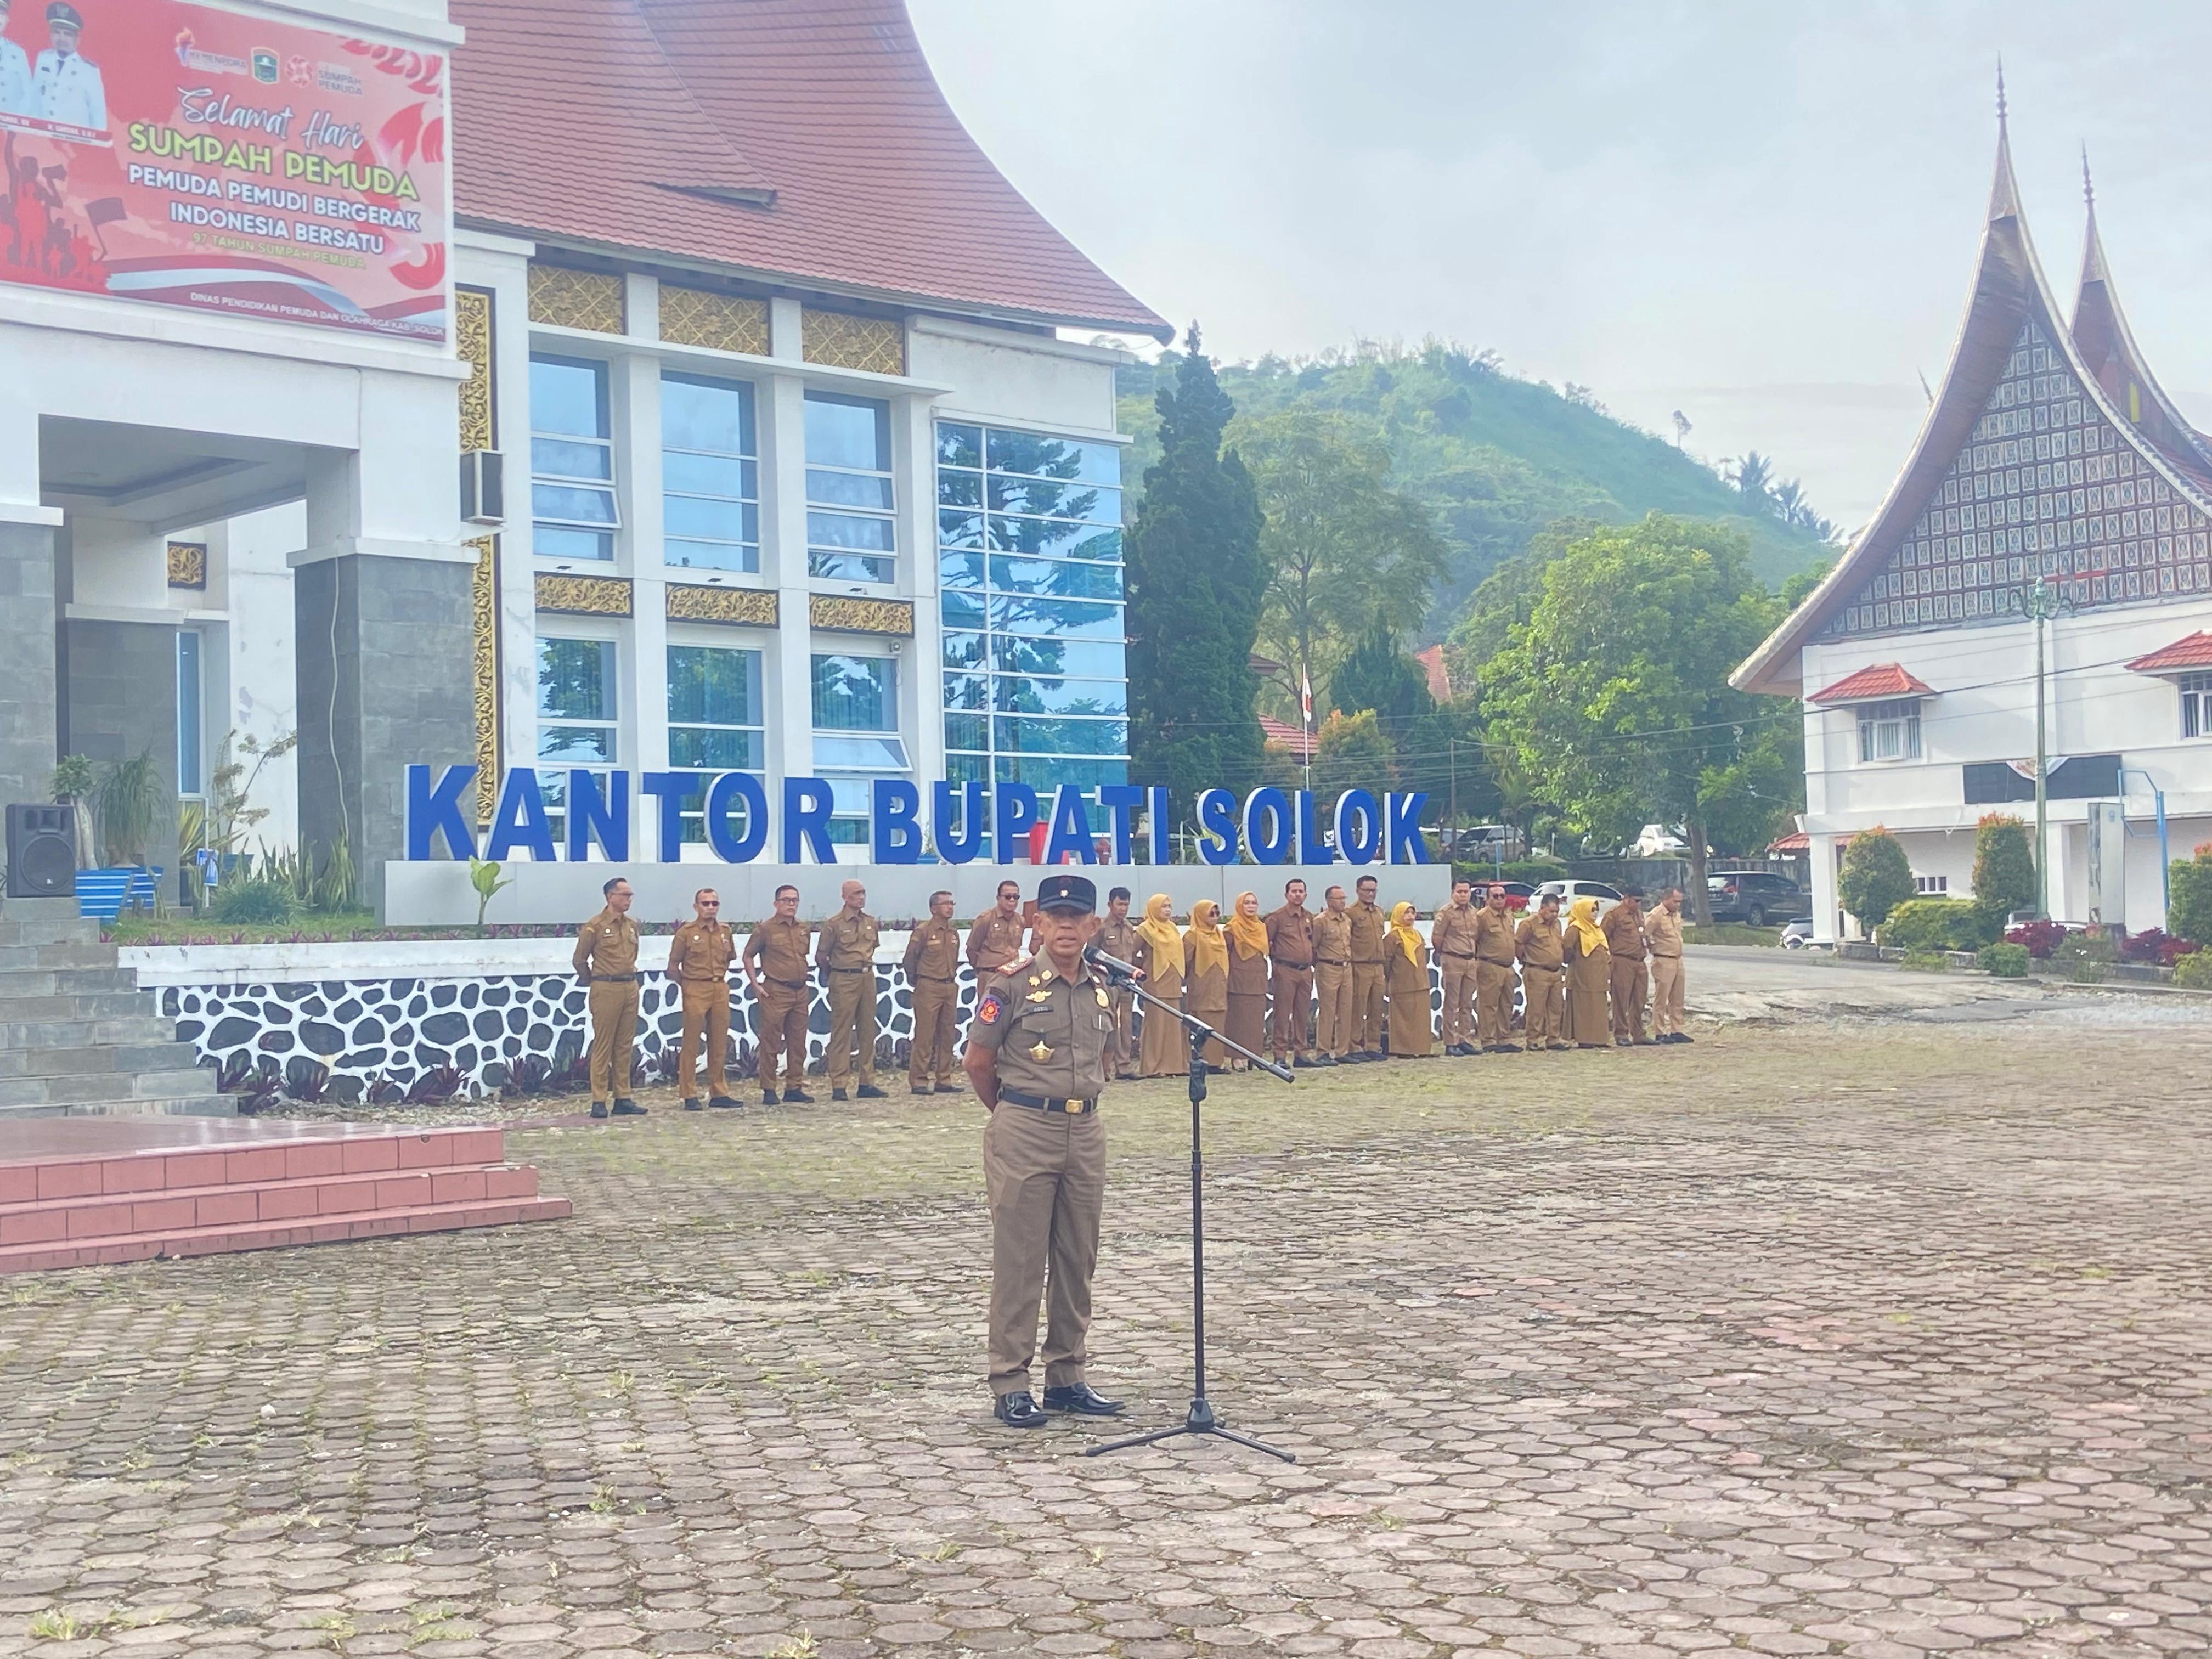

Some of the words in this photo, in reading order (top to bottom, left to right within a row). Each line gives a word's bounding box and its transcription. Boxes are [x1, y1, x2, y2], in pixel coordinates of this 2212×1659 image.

[318, 80, 363, 95] PEMUDA
[176, 86, 295, 140] Selamat
[301, 110, 364, 150] Hari
[129, 122, 272, 175] SUMPAH
[284, 150, 420, 202] PEMUDA
[128, 163, 223, 198] PEMUDA
[227, 180, 308, 213] PEMUDI
[313, 195, 421, 233] BERGERAK
[170, 201, 290, 239] INDONESIA
[295, 222, 385, 255] BERSATU
[193, 232, 207, 244] 97
[211, 234, 255, 251] TAHUN
[257, 242, 310, 261] SUMPAH
[312, 250, 366, 269] PEMUDA
[190, 292, 220, 304] DINAS
[221, 296, 278, 312] PENDIDIKAN
[280, 305, 319, 318] PEMUDA
[320, 311, 339, 320] DAN
[341, 314, 390, 328] OLAHRAGA
[404, 763, 837, 865] KANTOR
[870, 779, 1170, 866] BUPATI
[1194, 786, 1430, 866] SOLOK
